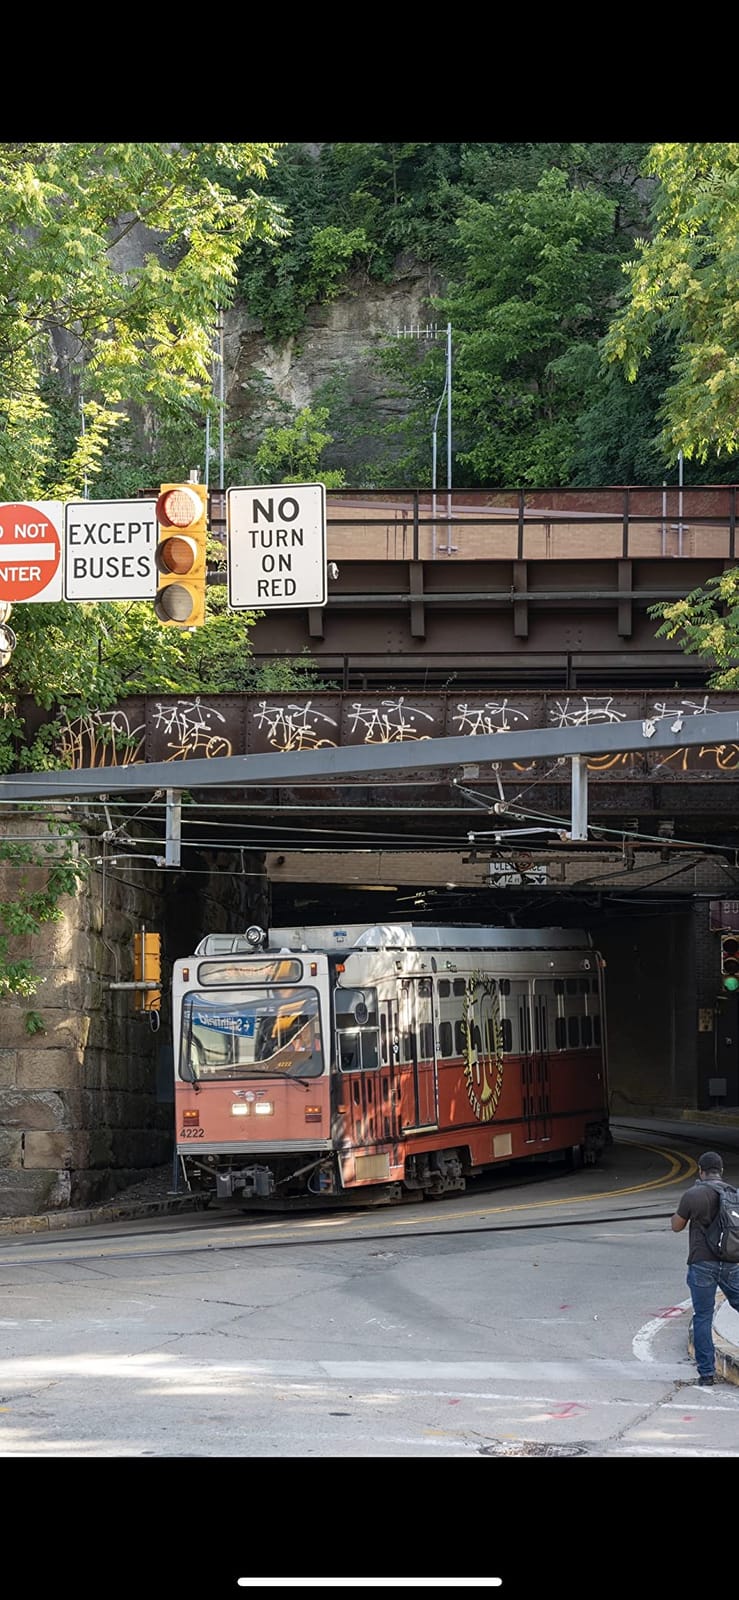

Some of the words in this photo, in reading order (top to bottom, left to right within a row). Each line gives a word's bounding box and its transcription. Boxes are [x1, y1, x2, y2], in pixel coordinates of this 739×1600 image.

[252, 497, 300, 523] NO
[14, 523, 48, 539] NOT
[69, 522, 154, 545] EXCEPT
[248, 528, 304, 548] TURN
[73, 556, 150, 579] BUSES
[261, 554, 292, 573] ON
[257, 578, 297, 598] RED
[180, 1128, 205, 1138] 4222
